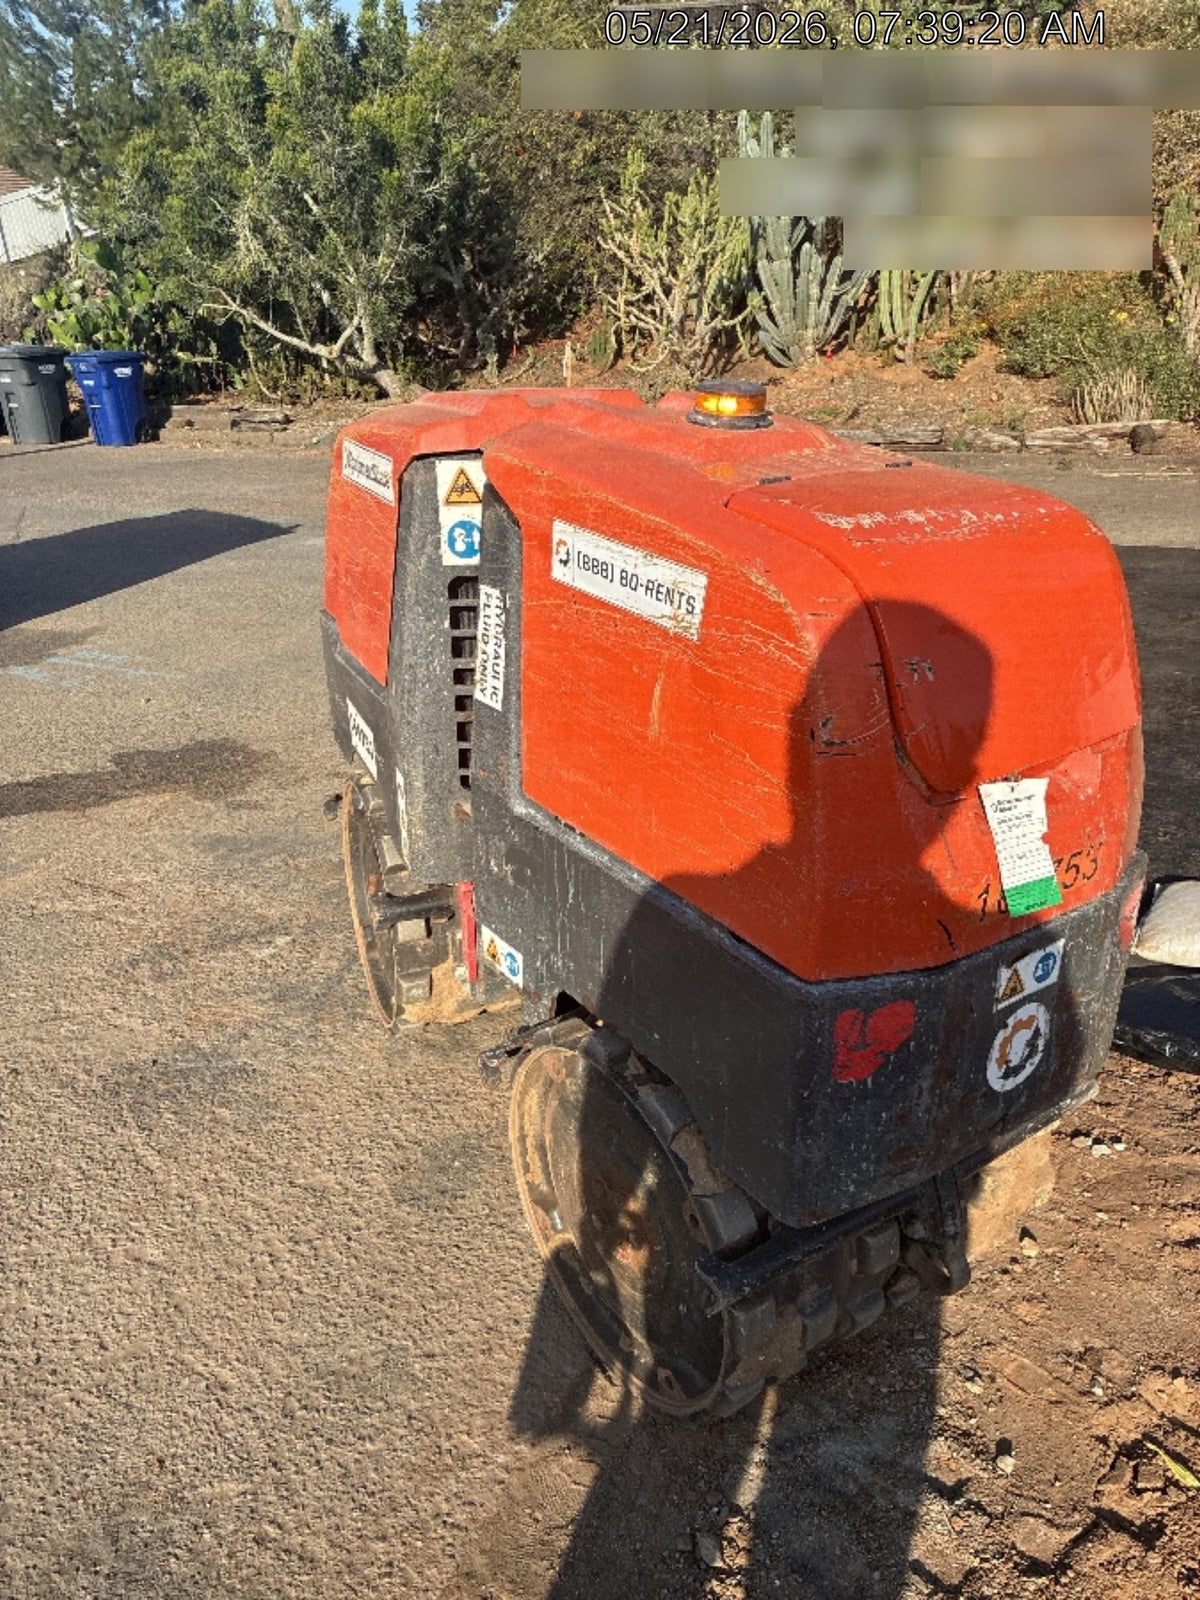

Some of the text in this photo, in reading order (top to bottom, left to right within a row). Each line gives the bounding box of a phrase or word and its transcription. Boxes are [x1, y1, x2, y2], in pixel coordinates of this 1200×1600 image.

[577, 550, 614, 583] (888)
[479, 591, 492, 698] FLUID ONLY
